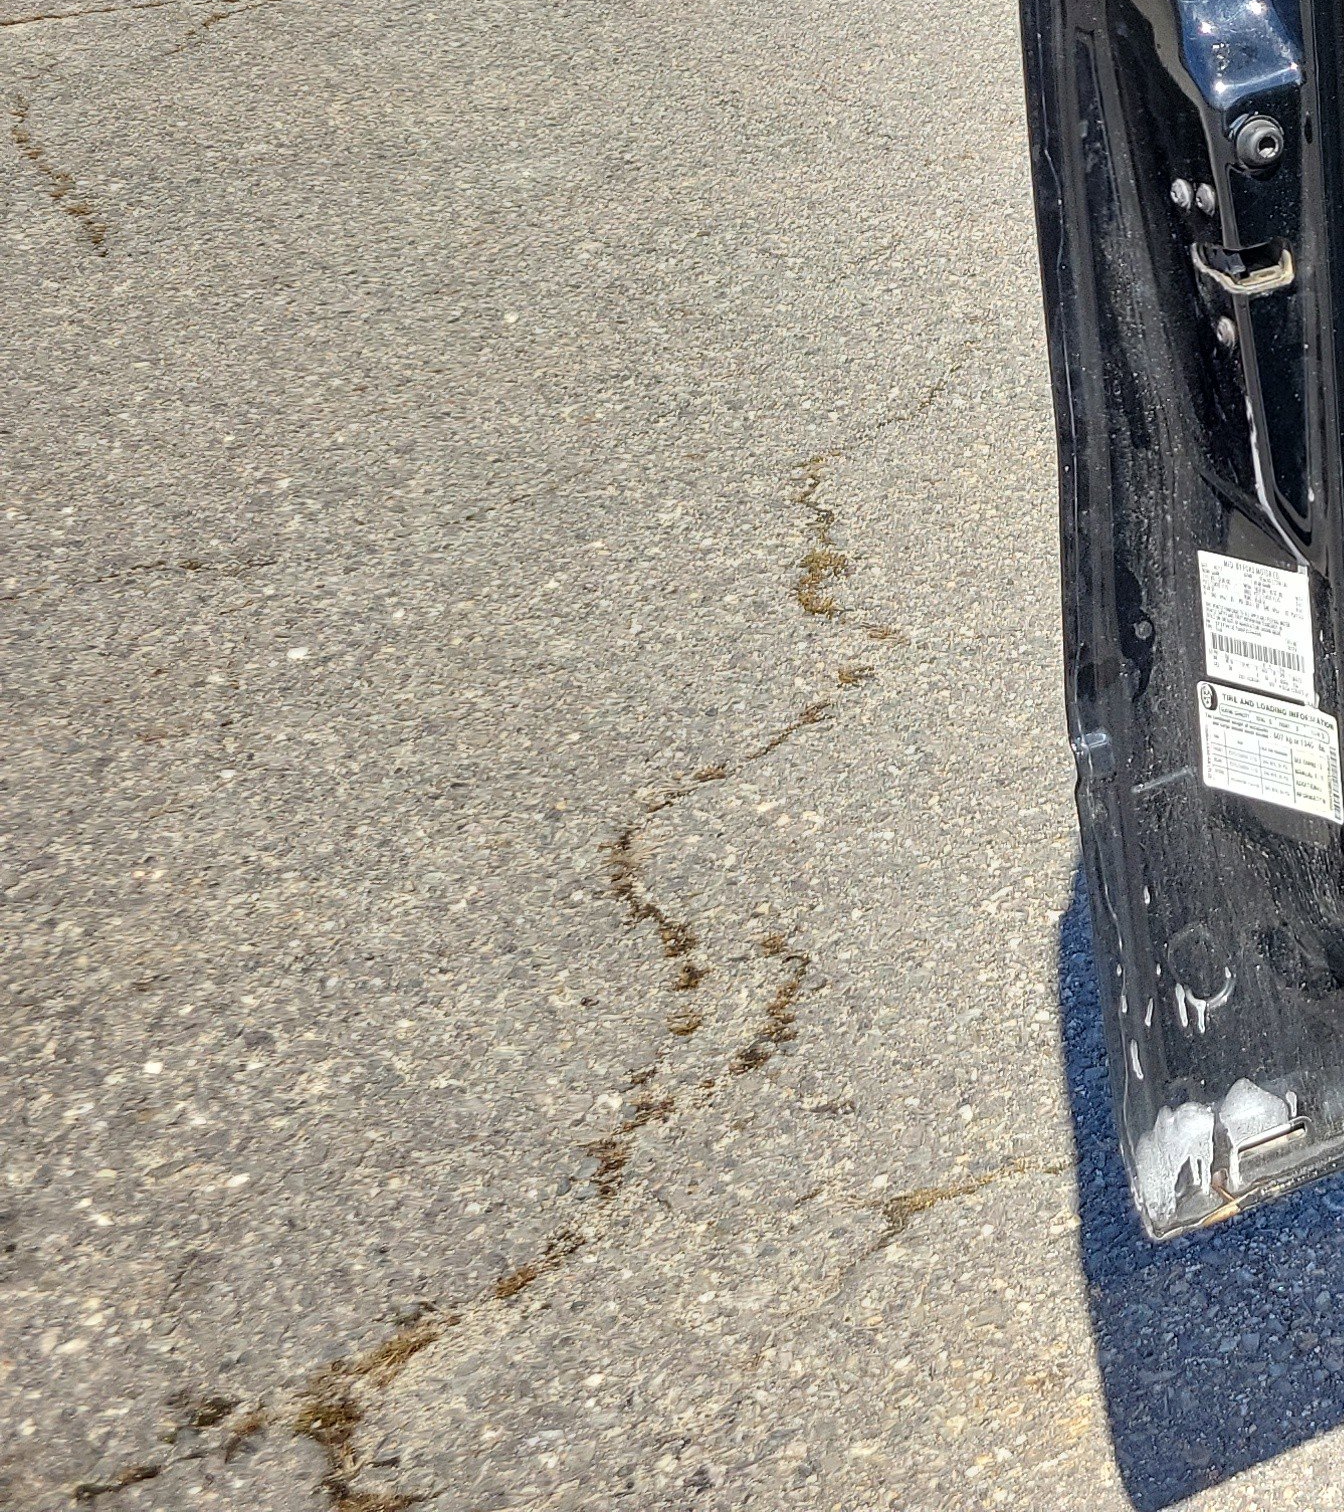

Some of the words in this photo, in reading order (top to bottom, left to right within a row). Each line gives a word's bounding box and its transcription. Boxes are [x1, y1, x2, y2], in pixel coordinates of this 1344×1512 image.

[1222, 693, 1238, 704] TIRE
[1239, 698, 1255, 707] AND
[1256, 702, 1287, 716] LOADING
[1289, 712, 1334, 730] INFORMATION
